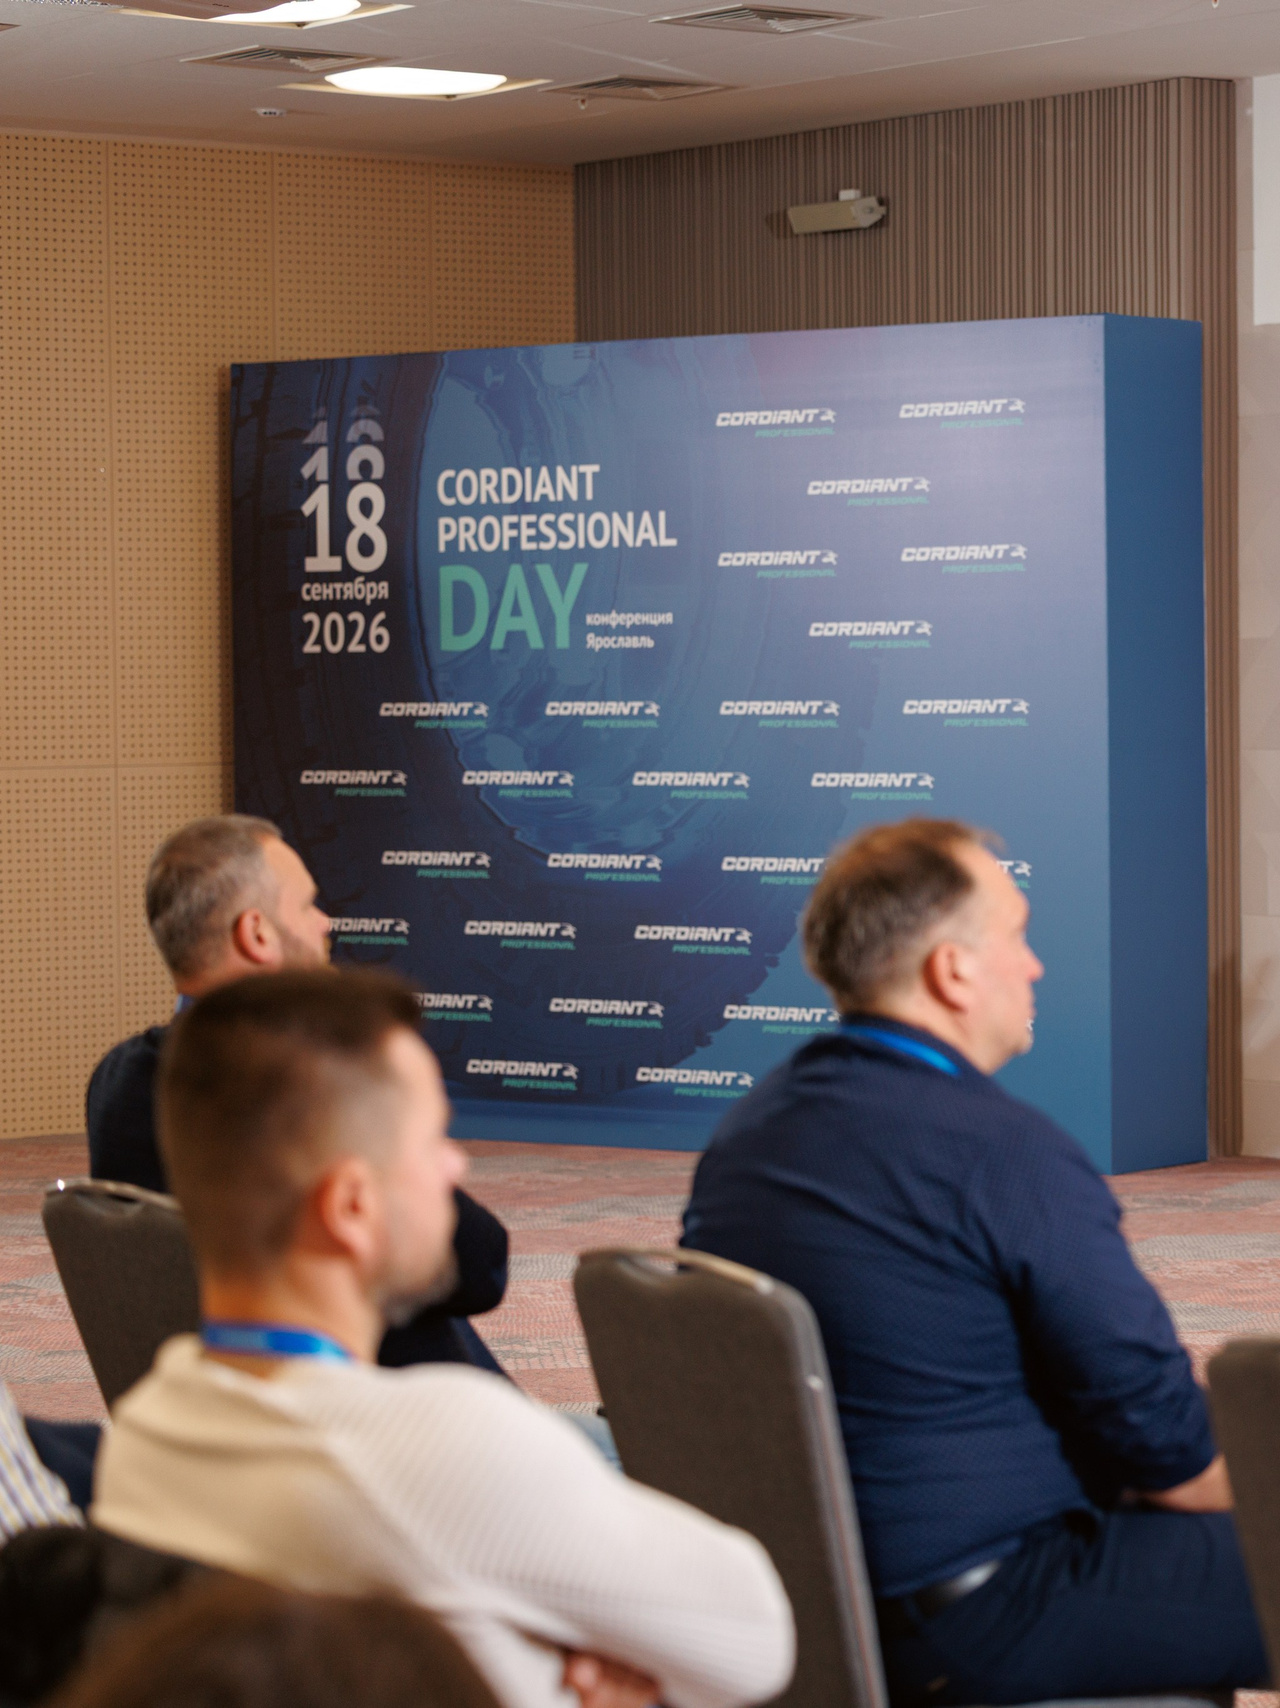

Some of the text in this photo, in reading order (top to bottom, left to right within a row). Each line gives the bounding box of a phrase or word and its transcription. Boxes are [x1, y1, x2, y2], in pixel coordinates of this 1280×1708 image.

[940, 418, 1024, 428] PROFESSIONAL
[755, 427, 835, 437] PROFESSIONAL
[437, 464, 600, 506] CORDIANT
[847, 497, 929, 506] PROFESSIONAL
[300, 481, 388, 574] 18
[437, 510, 677, 553] PROFESSIONAL
[757, 569, 837, 579] PROFESSIONAL
[942, 563, 1026, 574] PROFESSIONAL
[301, 577, 389, 606] сентября
[439, 562, 589, 652] DAY
[586, 610, 673, 628] конференция
[302, 611, 390, 654] 2026
[586, 632, 654, 652] Ярославль
[849, 639, 930, 649] PROFESSIONAL
[415, 719, 488, 729] PROFESSIONAL
[583, 719, 659, 729] PROFESSIONAL
[758, 719, 839, 728] PROFESSIONAL
[943, 717, 1029, 727] PROFESSIONAL
[335, 788, 406, 797] PROFESSIONAL
[499, 788, 573, 798] PROFESSIONAL
[670, 789, 749, 800] PROFESSIONAL
[851, 790, 933, 801] PROFESSIONAL
[416, 869, 490, 879] PROFESSIONAL
[584, 872, 661, 882] PROFESSIONAL
[329, 917, 395, 933] RDIANT
[500, 940, 575, 950] PROFESSIONAL
[672, 944, 751, 955] PROFESSIONAL
[586, 1017, 663, 1028] PROFESSIONAL
[503, 1078, 577, 1090] PROFESSIONAL
